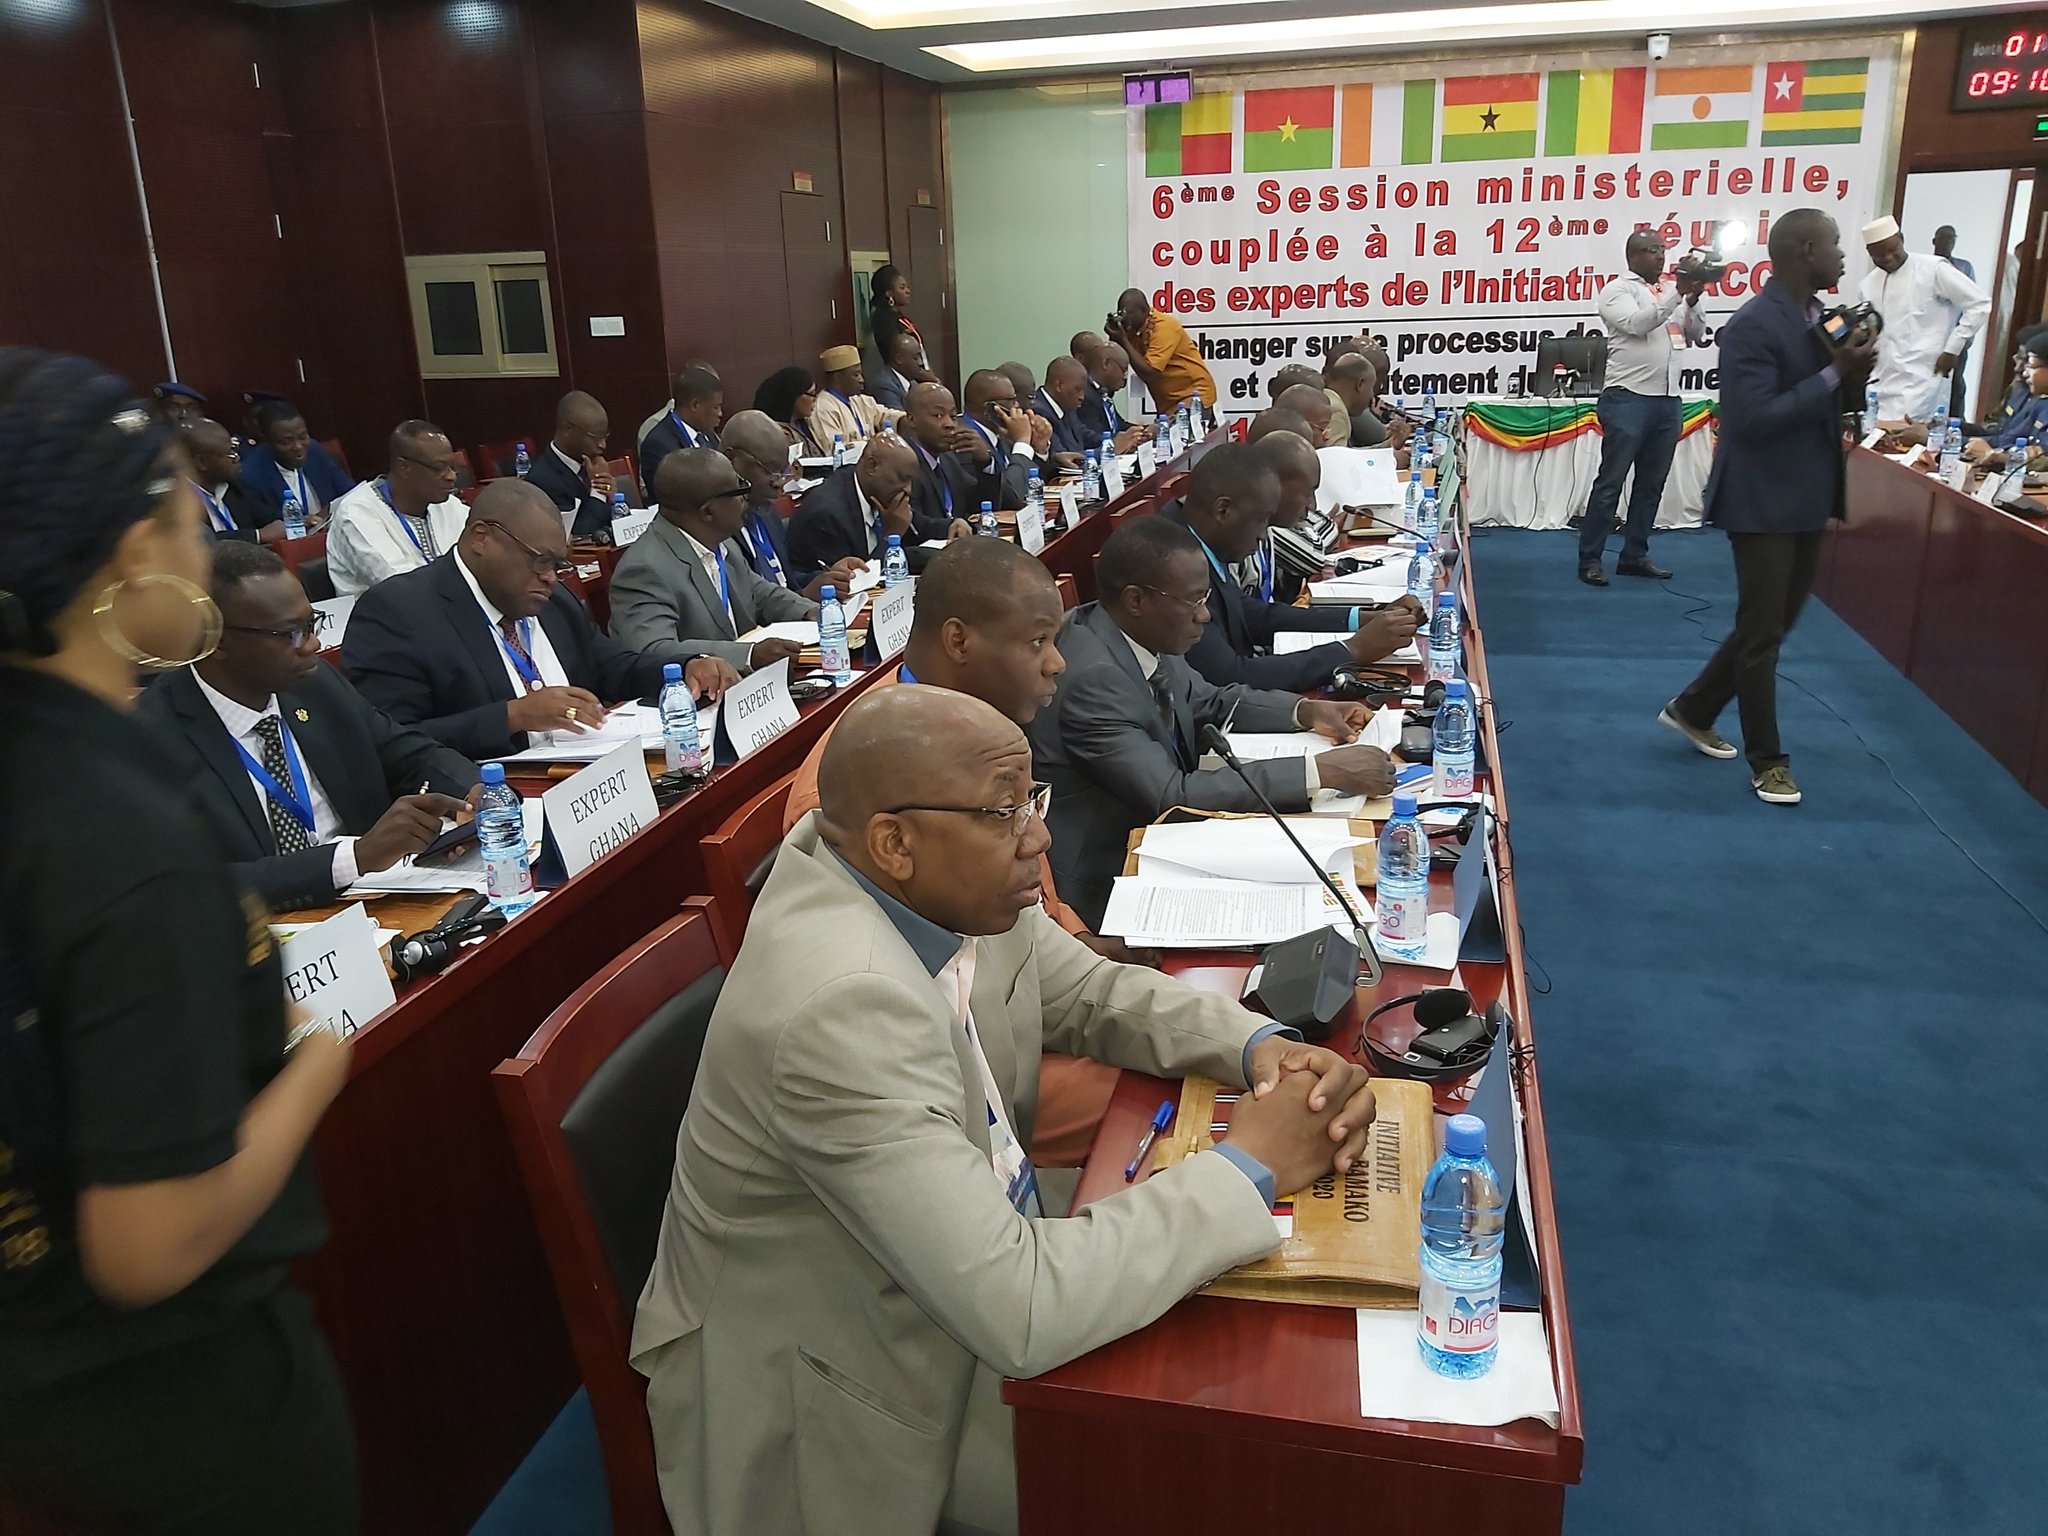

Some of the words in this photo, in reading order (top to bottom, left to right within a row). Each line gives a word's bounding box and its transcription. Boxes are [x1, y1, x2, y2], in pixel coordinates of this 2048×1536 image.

[2005, 35, 2043, 57] 01
[1152, 182, 1235, 219] 6ème
[1256, 174, 1449, 215] Session
[1477, 157, 1849, 205] ministerielle,
[1152, 227, 1339, 272] couplée
[1364, 223, 1388, 259] à
[1414, 222, 1457, 257] la
[1486, 215, 1609, 254] 12ème
[1152, 281, 1216, 313] des
[1227, 275, 1369, 318] experts
[1382, 272, 1429, 306] de
[1229, 370, 1259, 398] et
[881, 595, 905, 624] EXPERT
[737, 681, 775, 720] EXPERT
[751, 716, 788, 749] GHANA
[569, 768, 628, 825] EXPERT
[589, 811, 641, 864] GHANA
[284, 949, 340, 1005] ERT
[1376, 1119, 1401, 1195] INITIATIVE
[1343, 1160, 1370, 1222] BAMAKO
